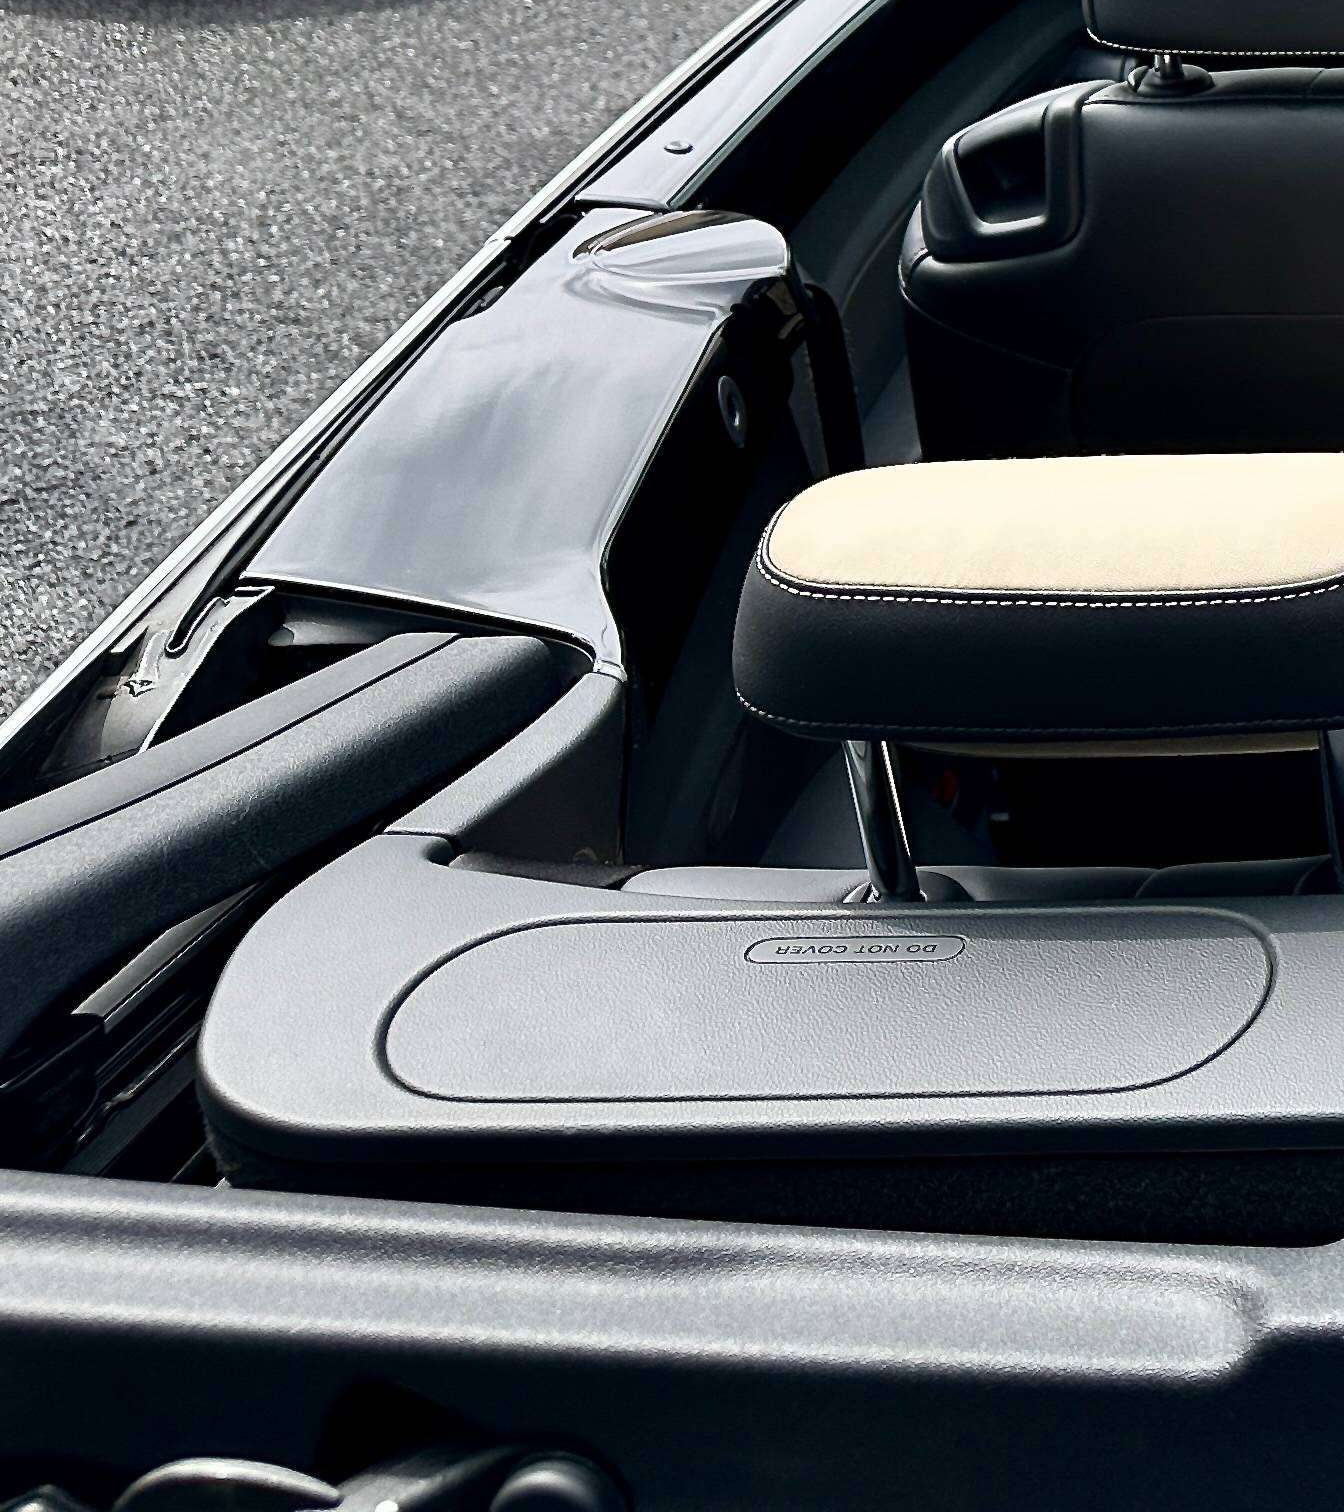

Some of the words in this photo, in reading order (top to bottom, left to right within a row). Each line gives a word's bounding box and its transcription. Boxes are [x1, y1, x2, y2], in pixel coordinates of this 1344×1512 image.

[776, 944, 847, 955] COVER
[854, 944, 900, 954] NOT
[907, 944, 938, 953] DO
